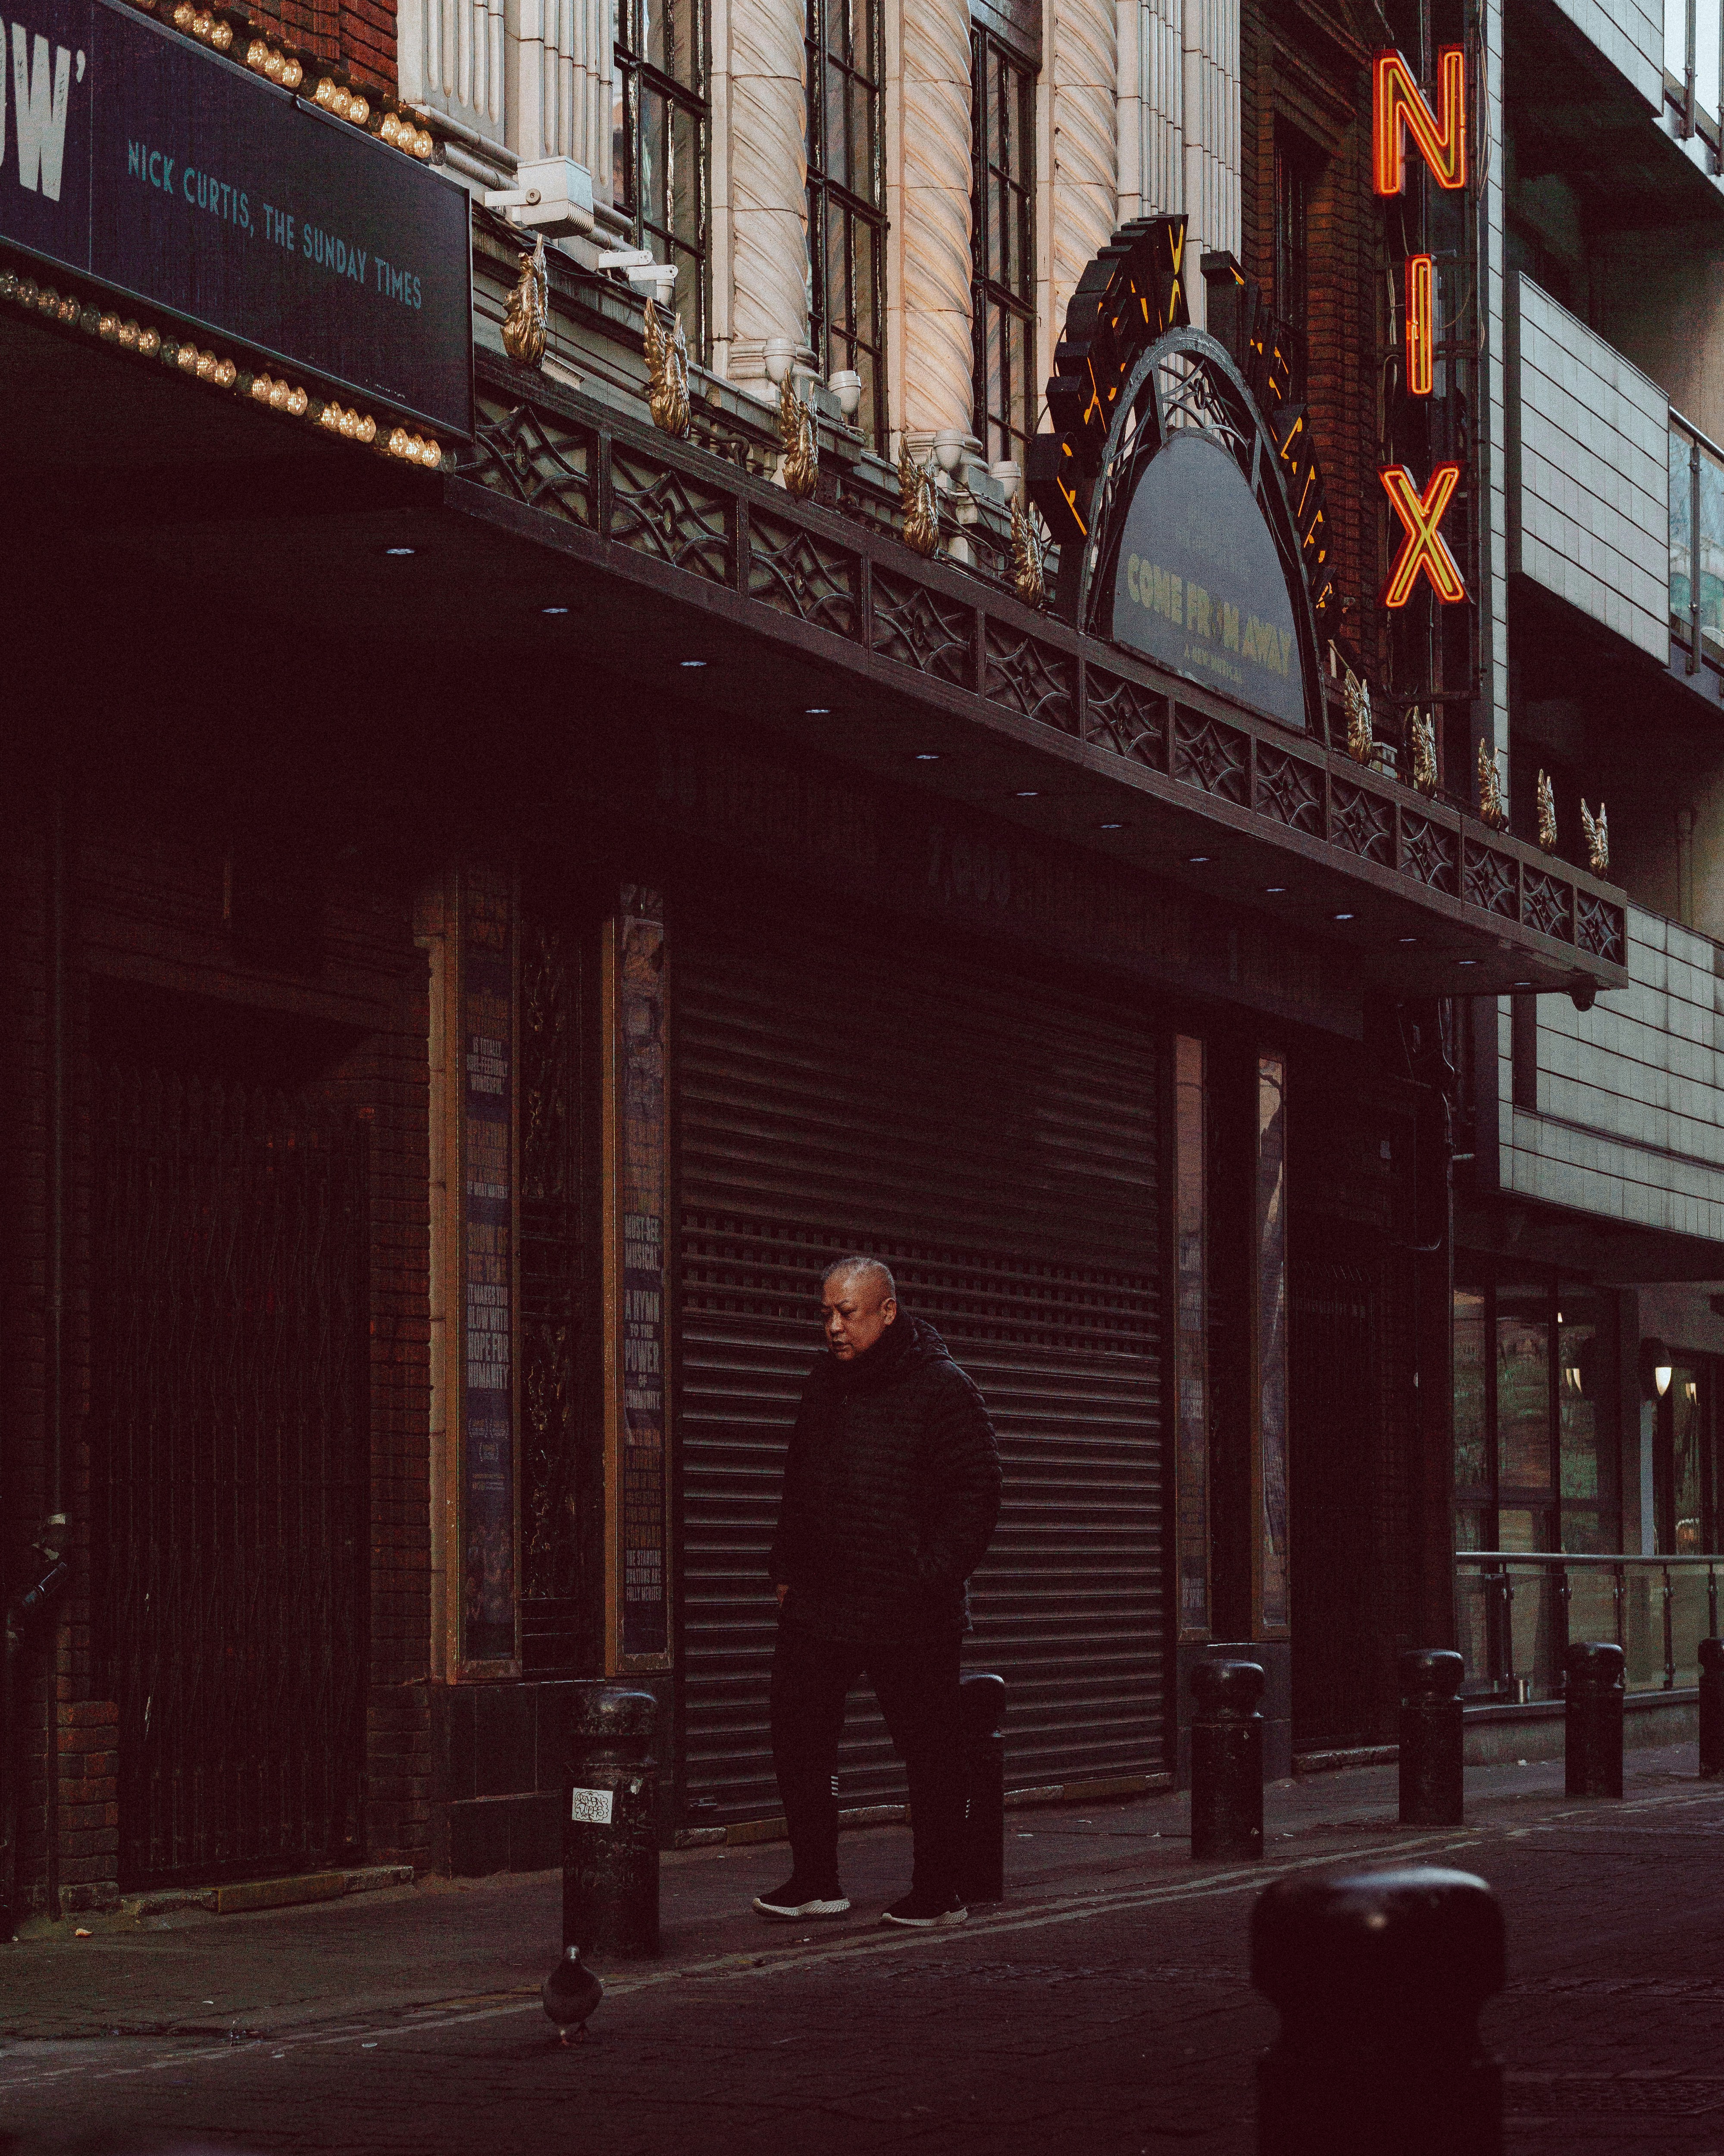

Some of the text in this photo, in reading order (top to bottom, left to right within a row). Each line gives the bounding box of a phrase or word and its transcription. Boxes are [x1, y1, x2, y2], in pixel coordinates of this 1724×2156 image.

[0, 16, 85, 202] W'
[128, 138, 421, 309] NICK CURTIS, THE SUNDAY TIMES
[1127, 553, 1182, 625] COME
[1242, 614, 1292, 677] AWAY
[473, 1036, 501, 1058] IS TOTALLY
[474, 1181, 487, 1197] WHAT
[625, 1214, 659, 1242] MUST-SEE
[467, 1253, 483, 1282] THE
[468, 1284, 508, 1306] IT MAKES YOU
[625, 1289, 659, 1322] A HYMN
[468, 1305, 508, 1331] GLOW WITH
[629, 1323, 653, 1338] TO THE
[468, 1331, 509, 1363] HOPE FOR
[625, 1339, 660, 1373] POWER
[638, 1374, 648, 1388] OF
[626, 1550, 661, 1567] THE STANDING
[626, 1568, 661, 1584] OVATIONS ARE
[626, 1586, 640, 1601] FULLY
